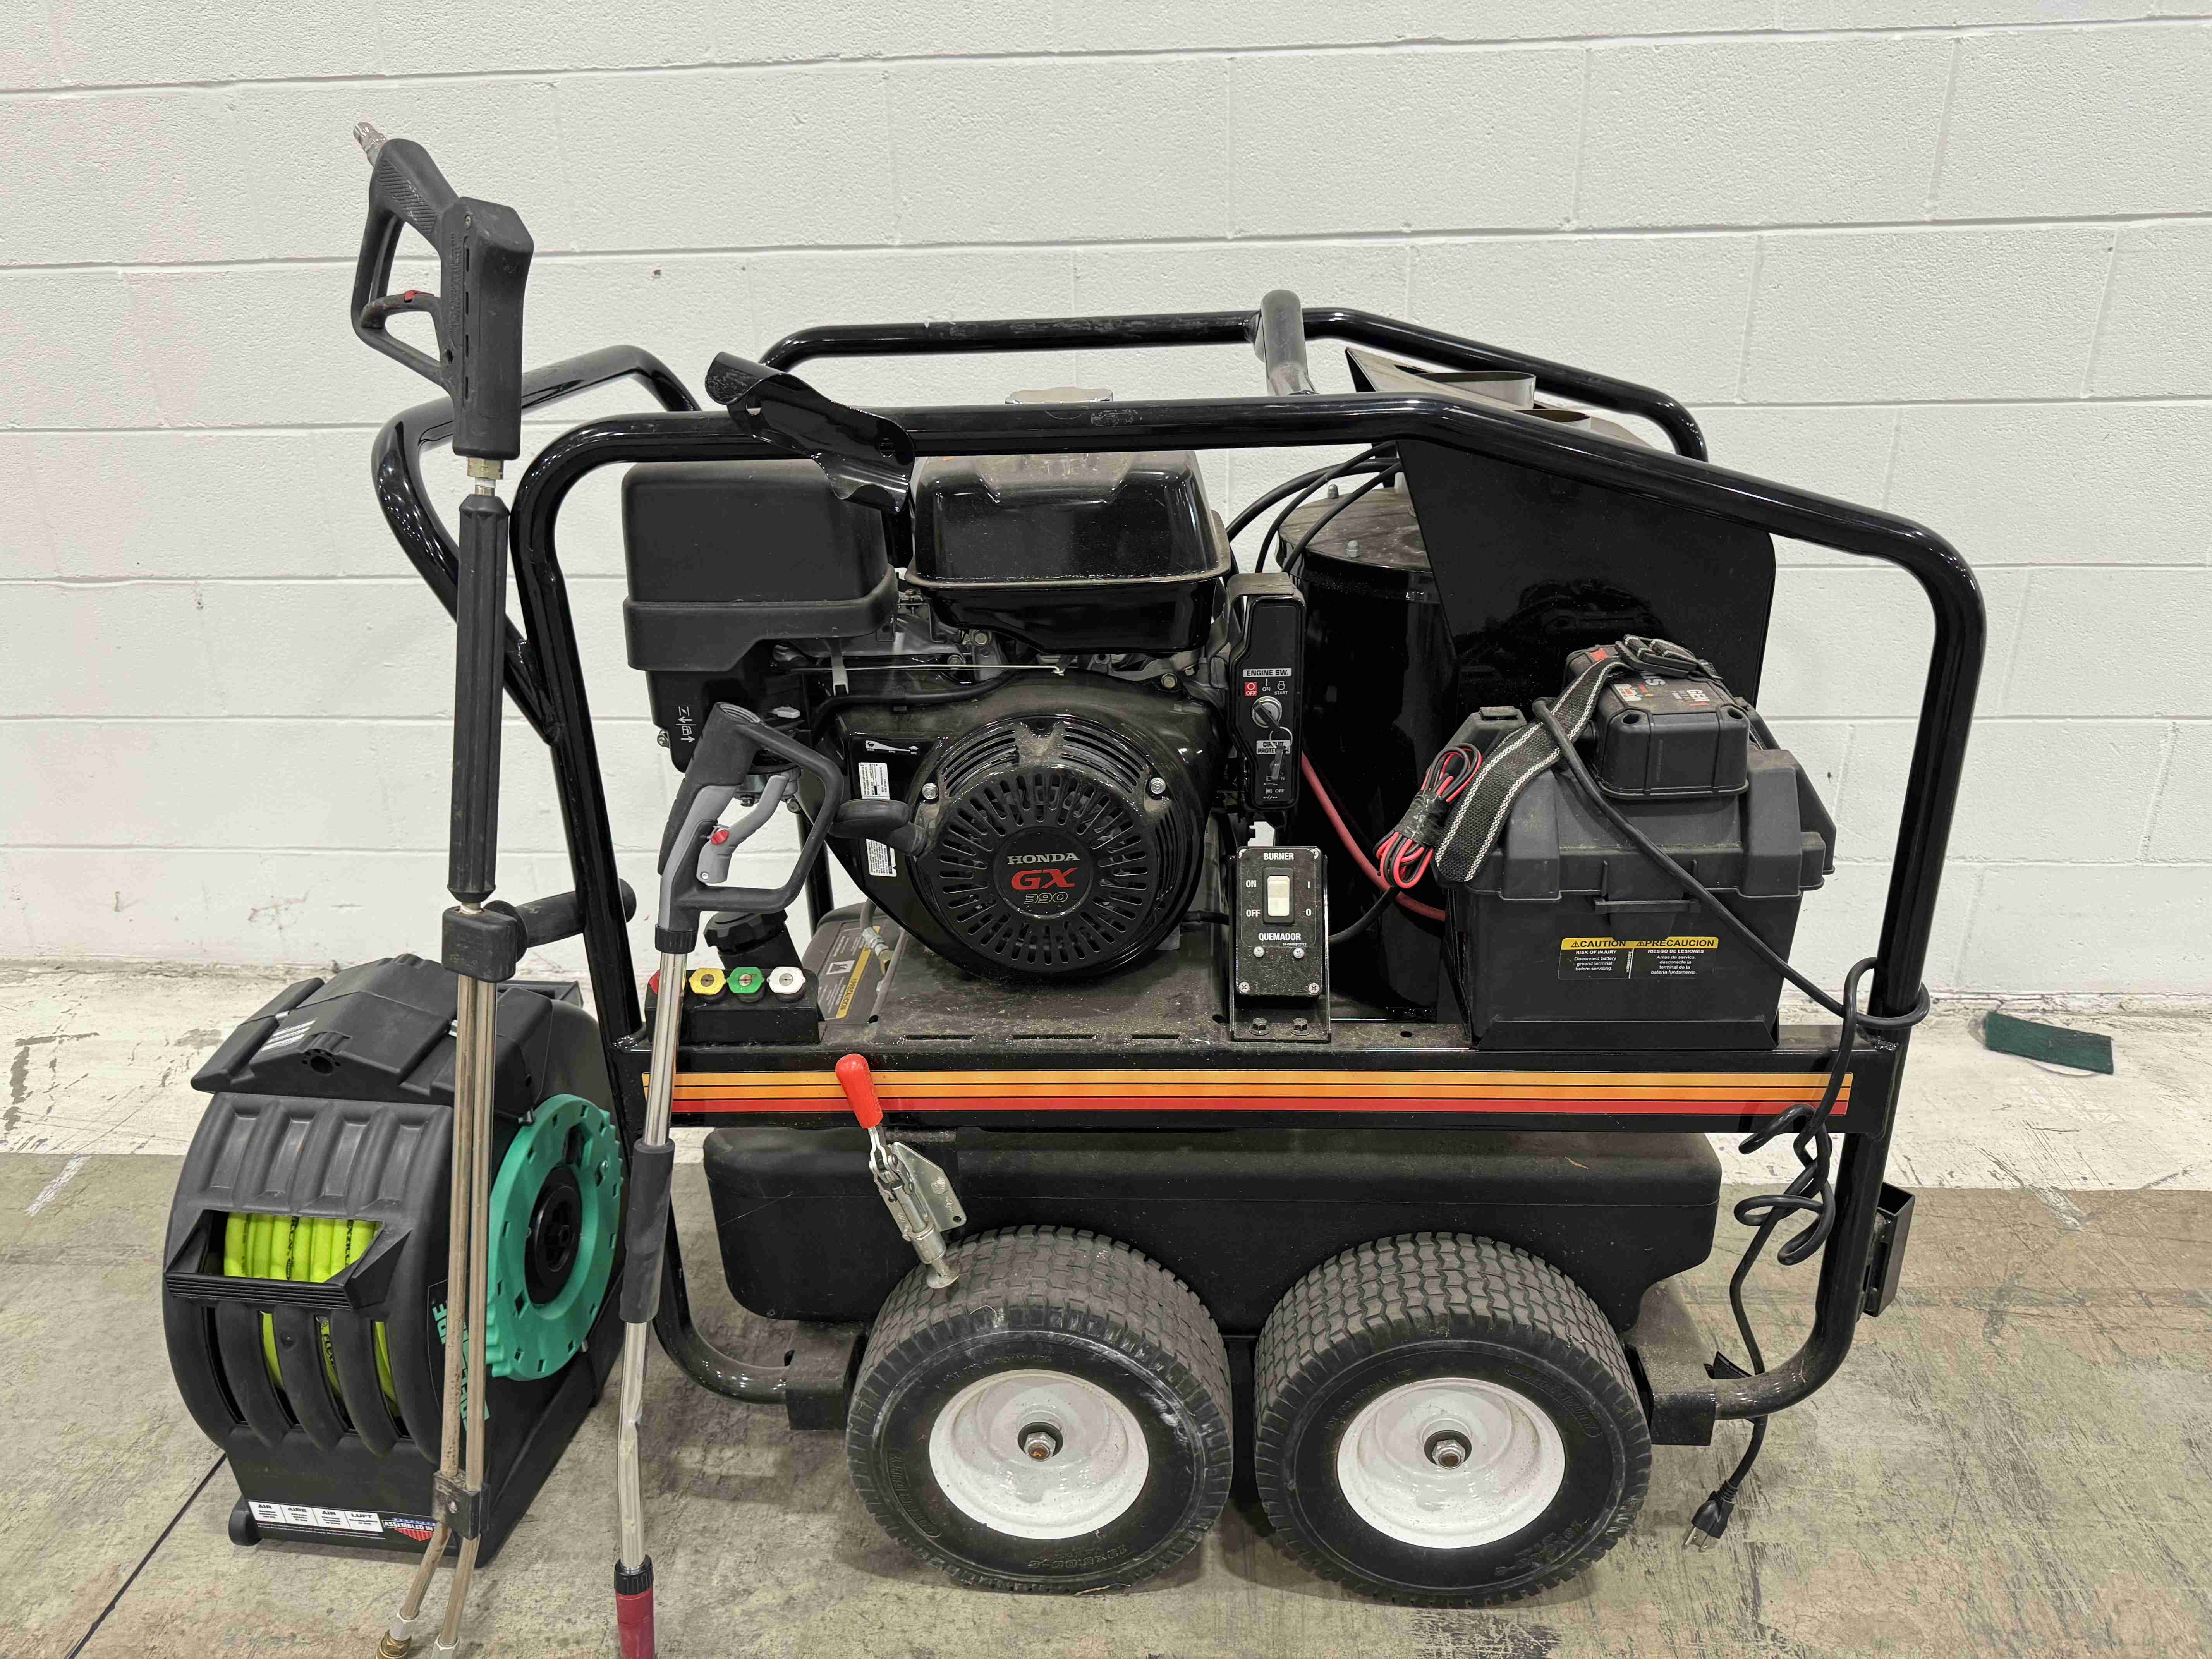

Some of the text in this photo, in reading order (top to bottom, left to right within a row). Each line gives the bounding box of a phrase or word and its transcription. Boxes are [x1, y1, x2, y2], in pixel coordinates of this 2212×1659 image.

[1007, 853, 1080, 864] HONDA
[1011, 867, 1078, 890] GX
[1024, 892, 1068, 904] 390
[384, 1521, 424, 1530] ASSEMBLED
